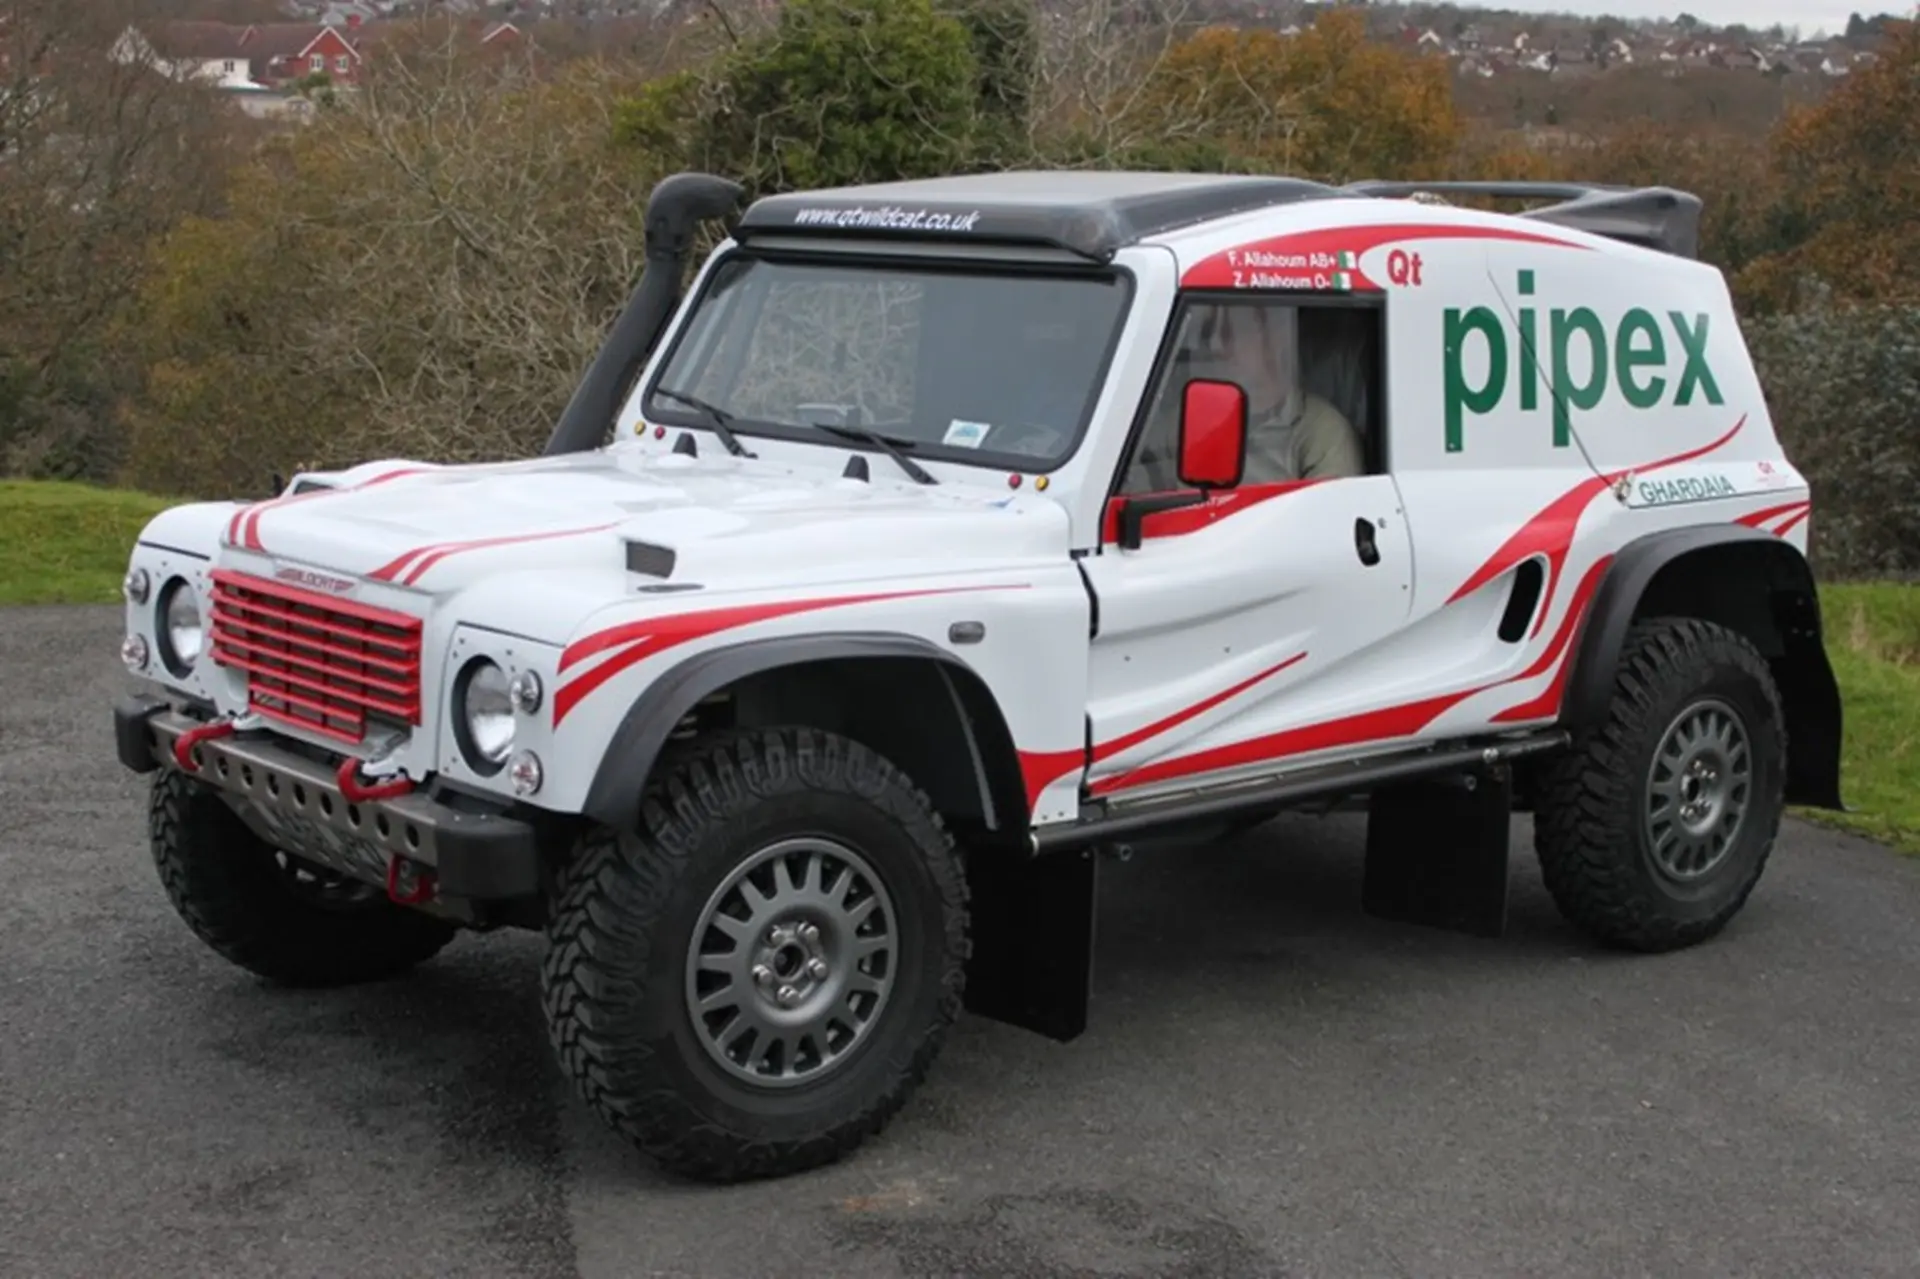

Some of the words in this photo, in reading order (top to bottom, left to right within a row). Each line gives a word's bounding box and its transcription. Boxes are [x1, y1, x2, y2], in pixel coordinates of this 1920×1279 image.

[794, 206, 979, 231] www.qtwildcat.co.uk
[1245, 252, 1306, 268] Allahoum
[1387, 250, 1422, 286] Qt
[1250, 273, 1311, 288] Allahoum
[1443, 269, 1725, 452] pipex
[1638, 475, 1736, 504] GHARDAIA
